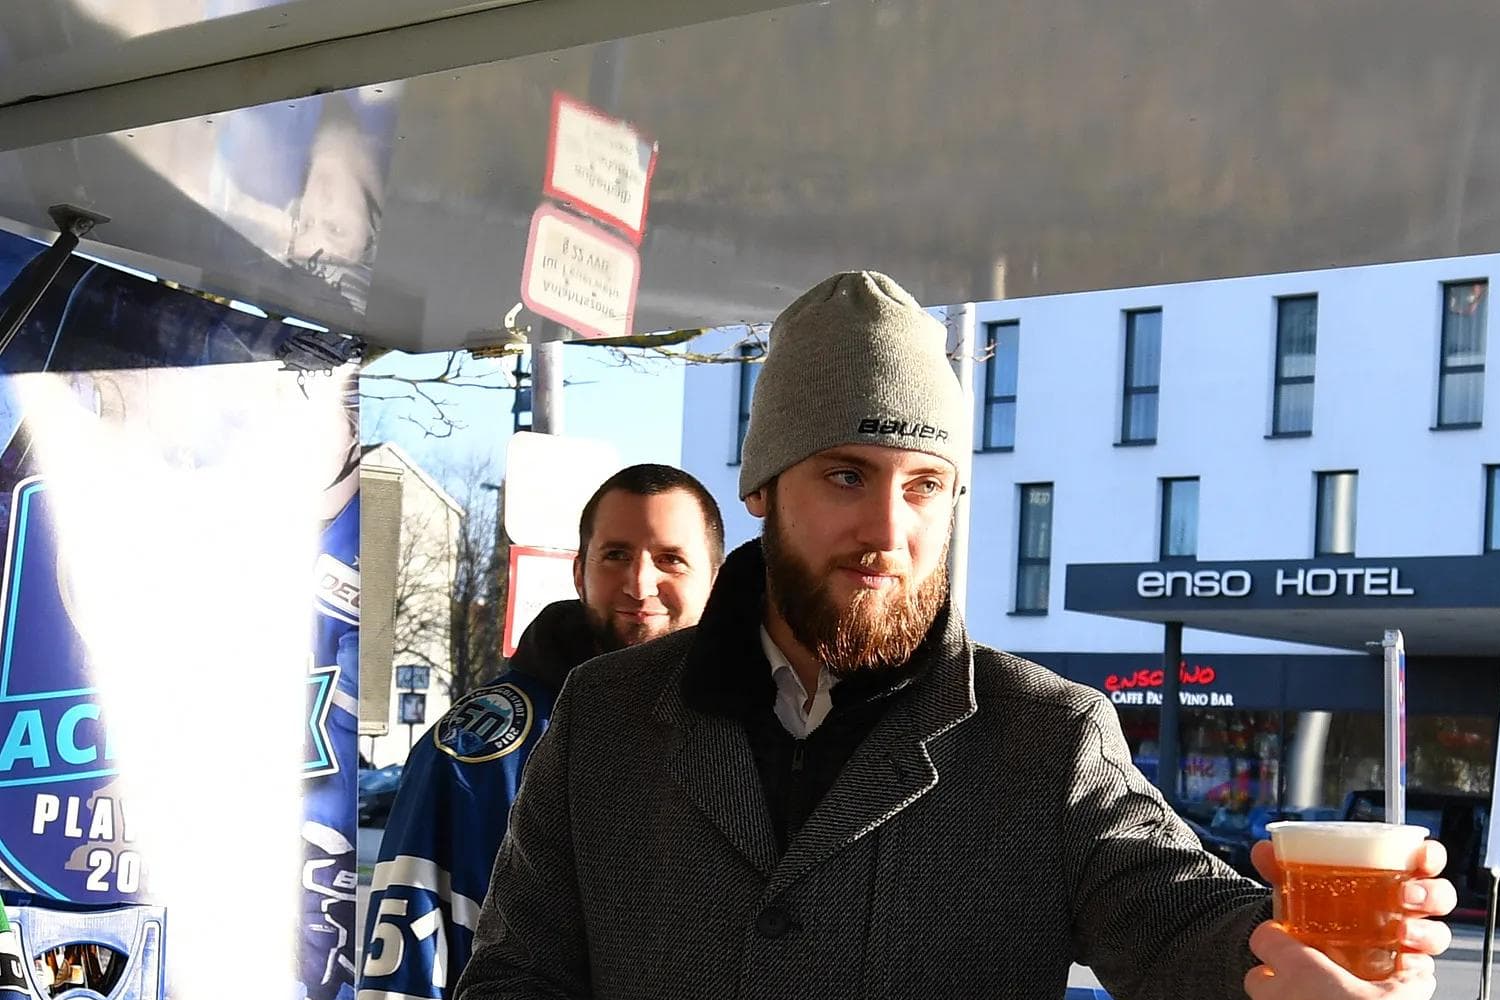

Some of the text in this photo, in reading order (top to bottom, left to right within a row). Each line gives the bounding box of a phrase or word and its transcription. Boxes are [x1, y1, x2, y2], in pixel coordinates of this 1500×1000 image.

[1137, 567, 1415, 597] enso HOTEL
[363, 899, 449, 989] 51
